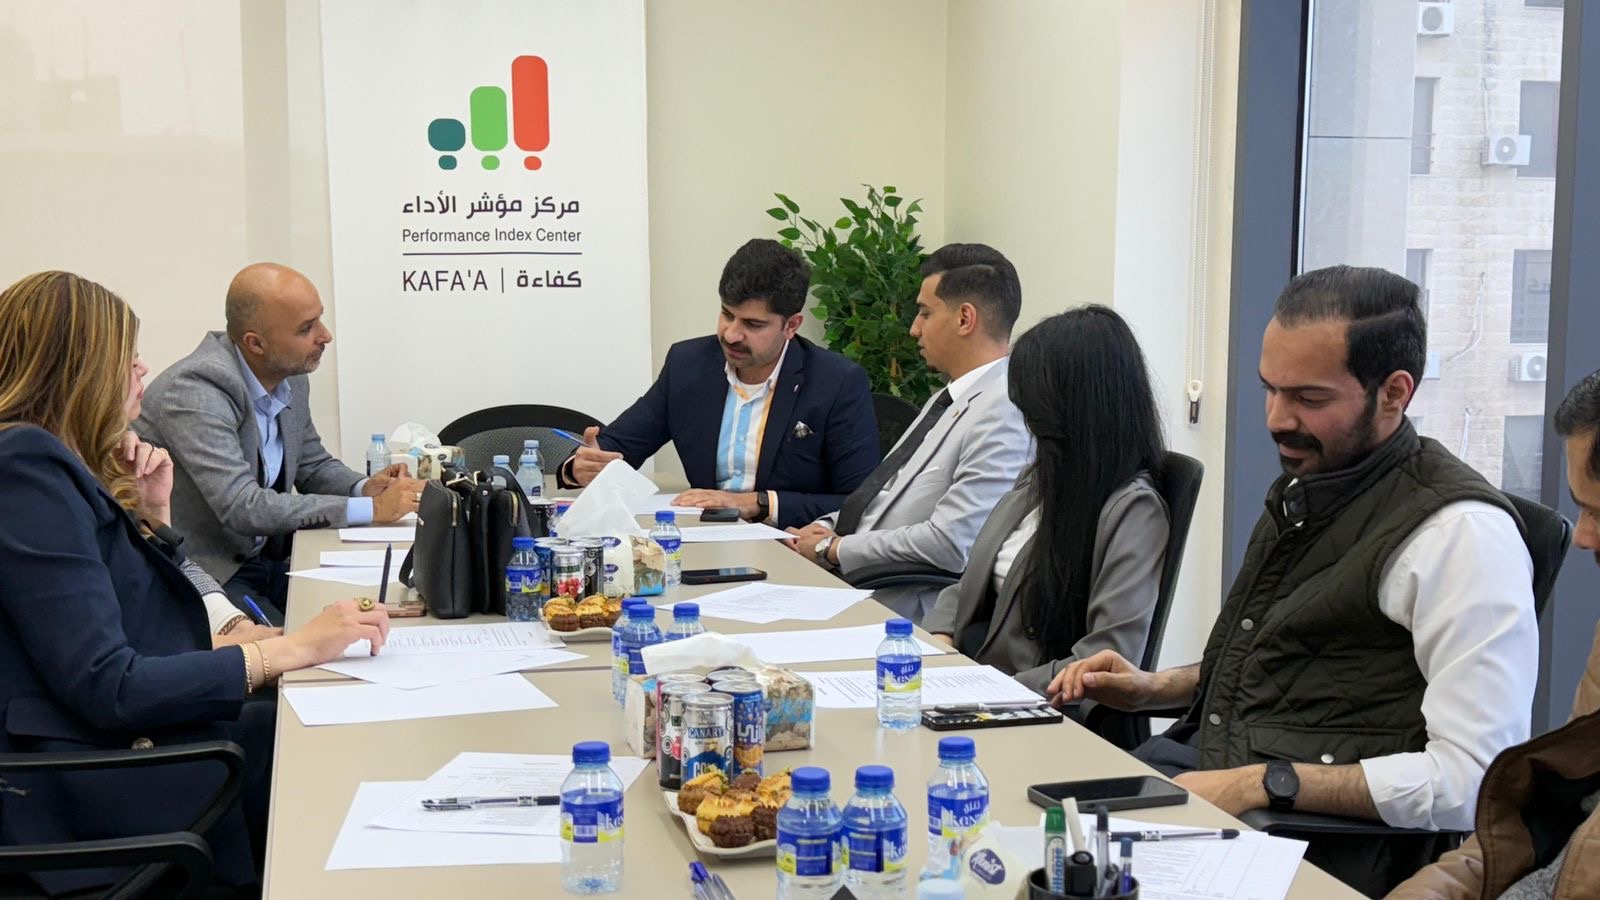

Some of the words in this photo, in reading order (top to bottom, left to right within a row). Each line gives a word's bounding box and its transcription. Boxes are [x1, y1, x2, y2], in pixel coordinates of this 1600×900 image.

[402, 190, 457, 214] الأداء
[466, 192, 522, 219] مؤشر
[531, 196, 580, 219] مركز
[402, 228, 490, 242] Performance
[495, 228, 532, 241] Index
[536, 228, 582, 242] Center
[402, 269, 489, 292] KAFA'A
[516, 269, 582, 289] كفاءة
[688, 727, 725, 738] CANARY
